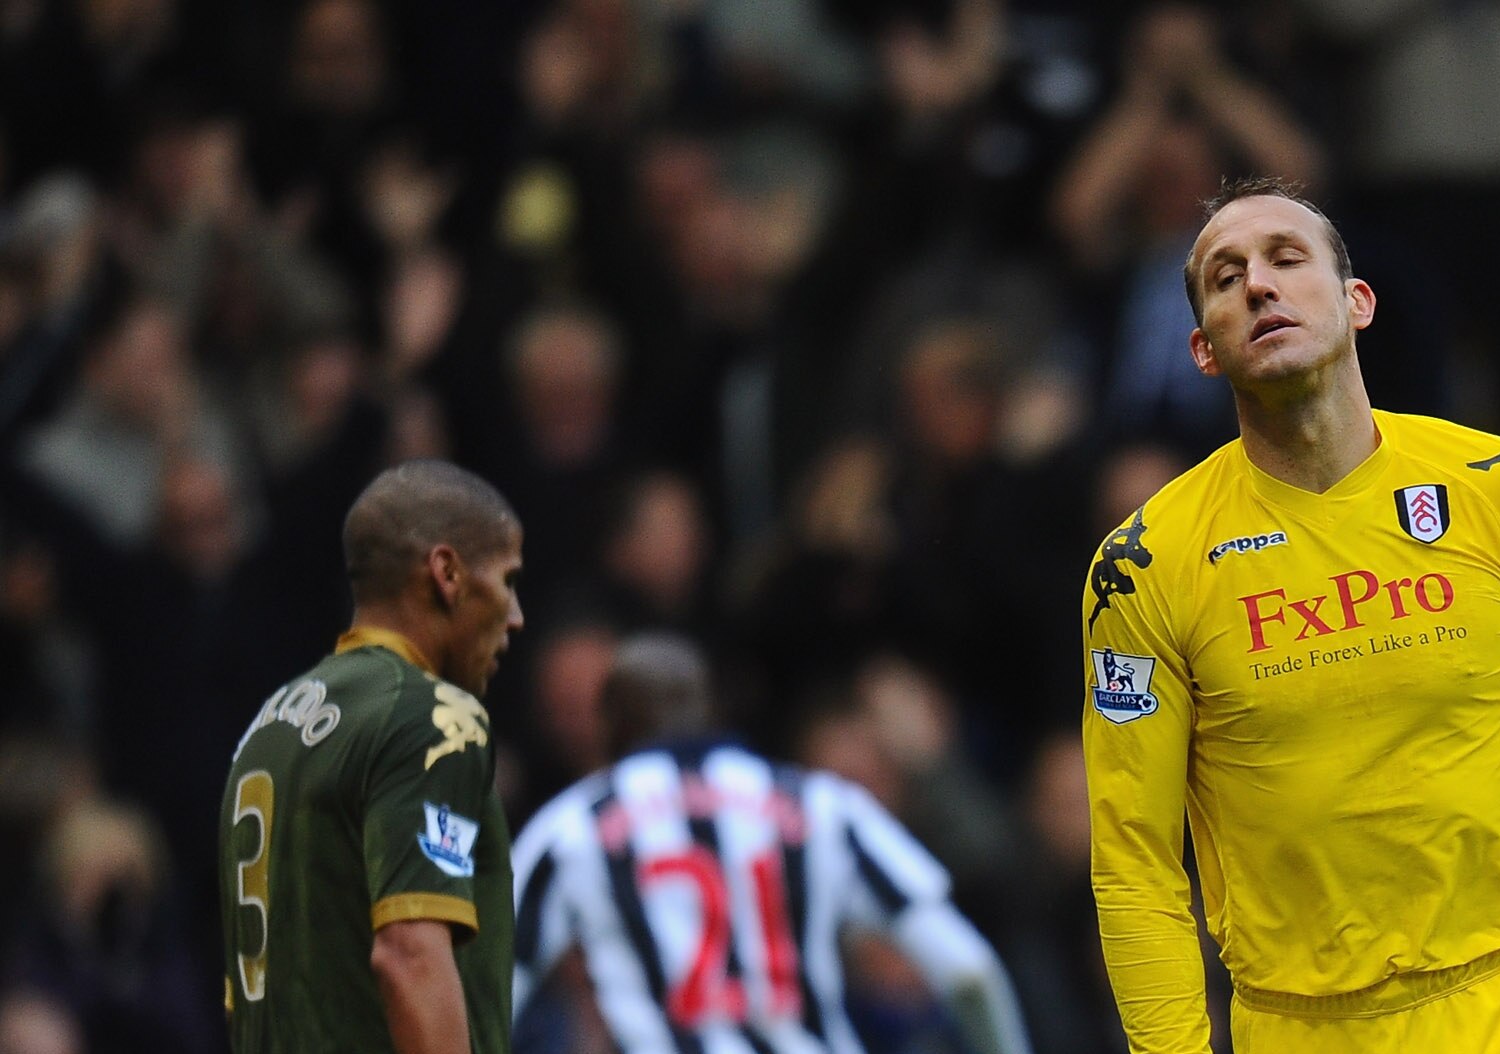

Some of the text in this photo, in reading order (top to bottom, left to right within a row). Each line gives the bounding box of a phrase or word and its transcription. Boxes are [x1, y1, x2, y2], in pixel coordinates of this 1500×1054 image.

[1237, 569, 1455, 654] FxPro
[1249, 624, 1468, 681] Trade Forex Like a Pro
[637, 845, 804, 1030] 21
